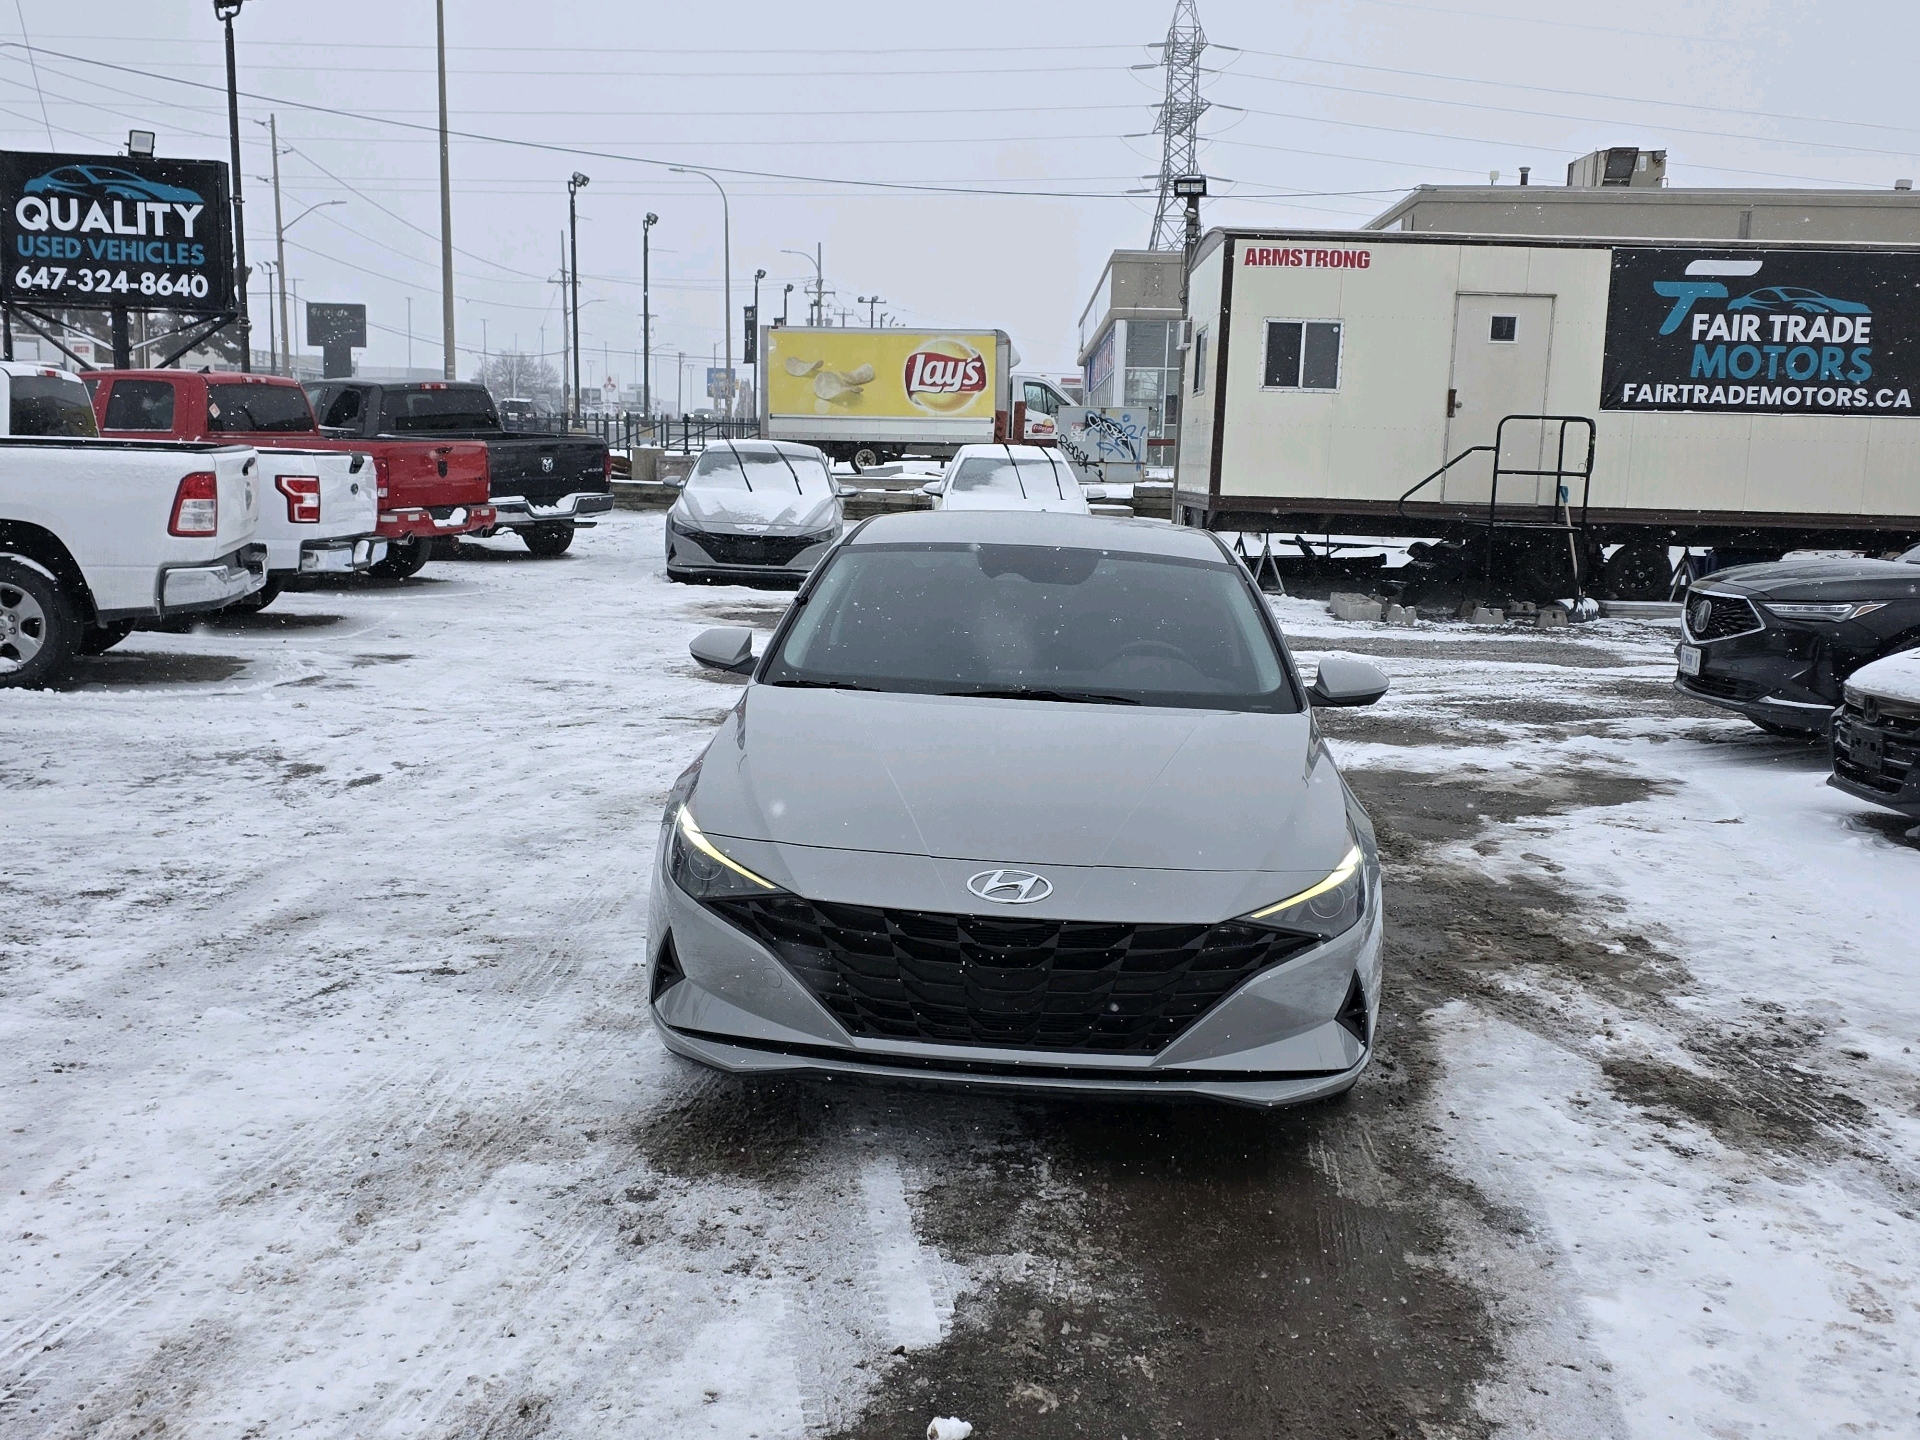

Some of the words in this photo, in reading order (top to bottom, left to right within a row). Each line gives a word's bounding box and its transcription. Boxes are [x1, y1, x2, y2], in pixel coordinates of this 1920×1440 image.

[15, 195, 205, 238] QUALITY
[16, 234, 82, 259] USED
[87, 237, 206, 266] VEHICLES
[1243, 248, 1371, 269] ARMSTRONG
[15, 265, 209, 298] 647-324-8640
[1691, 313, 1761, 342] FAIR
[1769, 313, 1872, 344] TRADE
[909, 354, 982, 393] Lay's
[1690, 344, 1873, 382] MOTORS
[1623, 383, 1912, 408] FAIRTRADEMOTORS.CA
